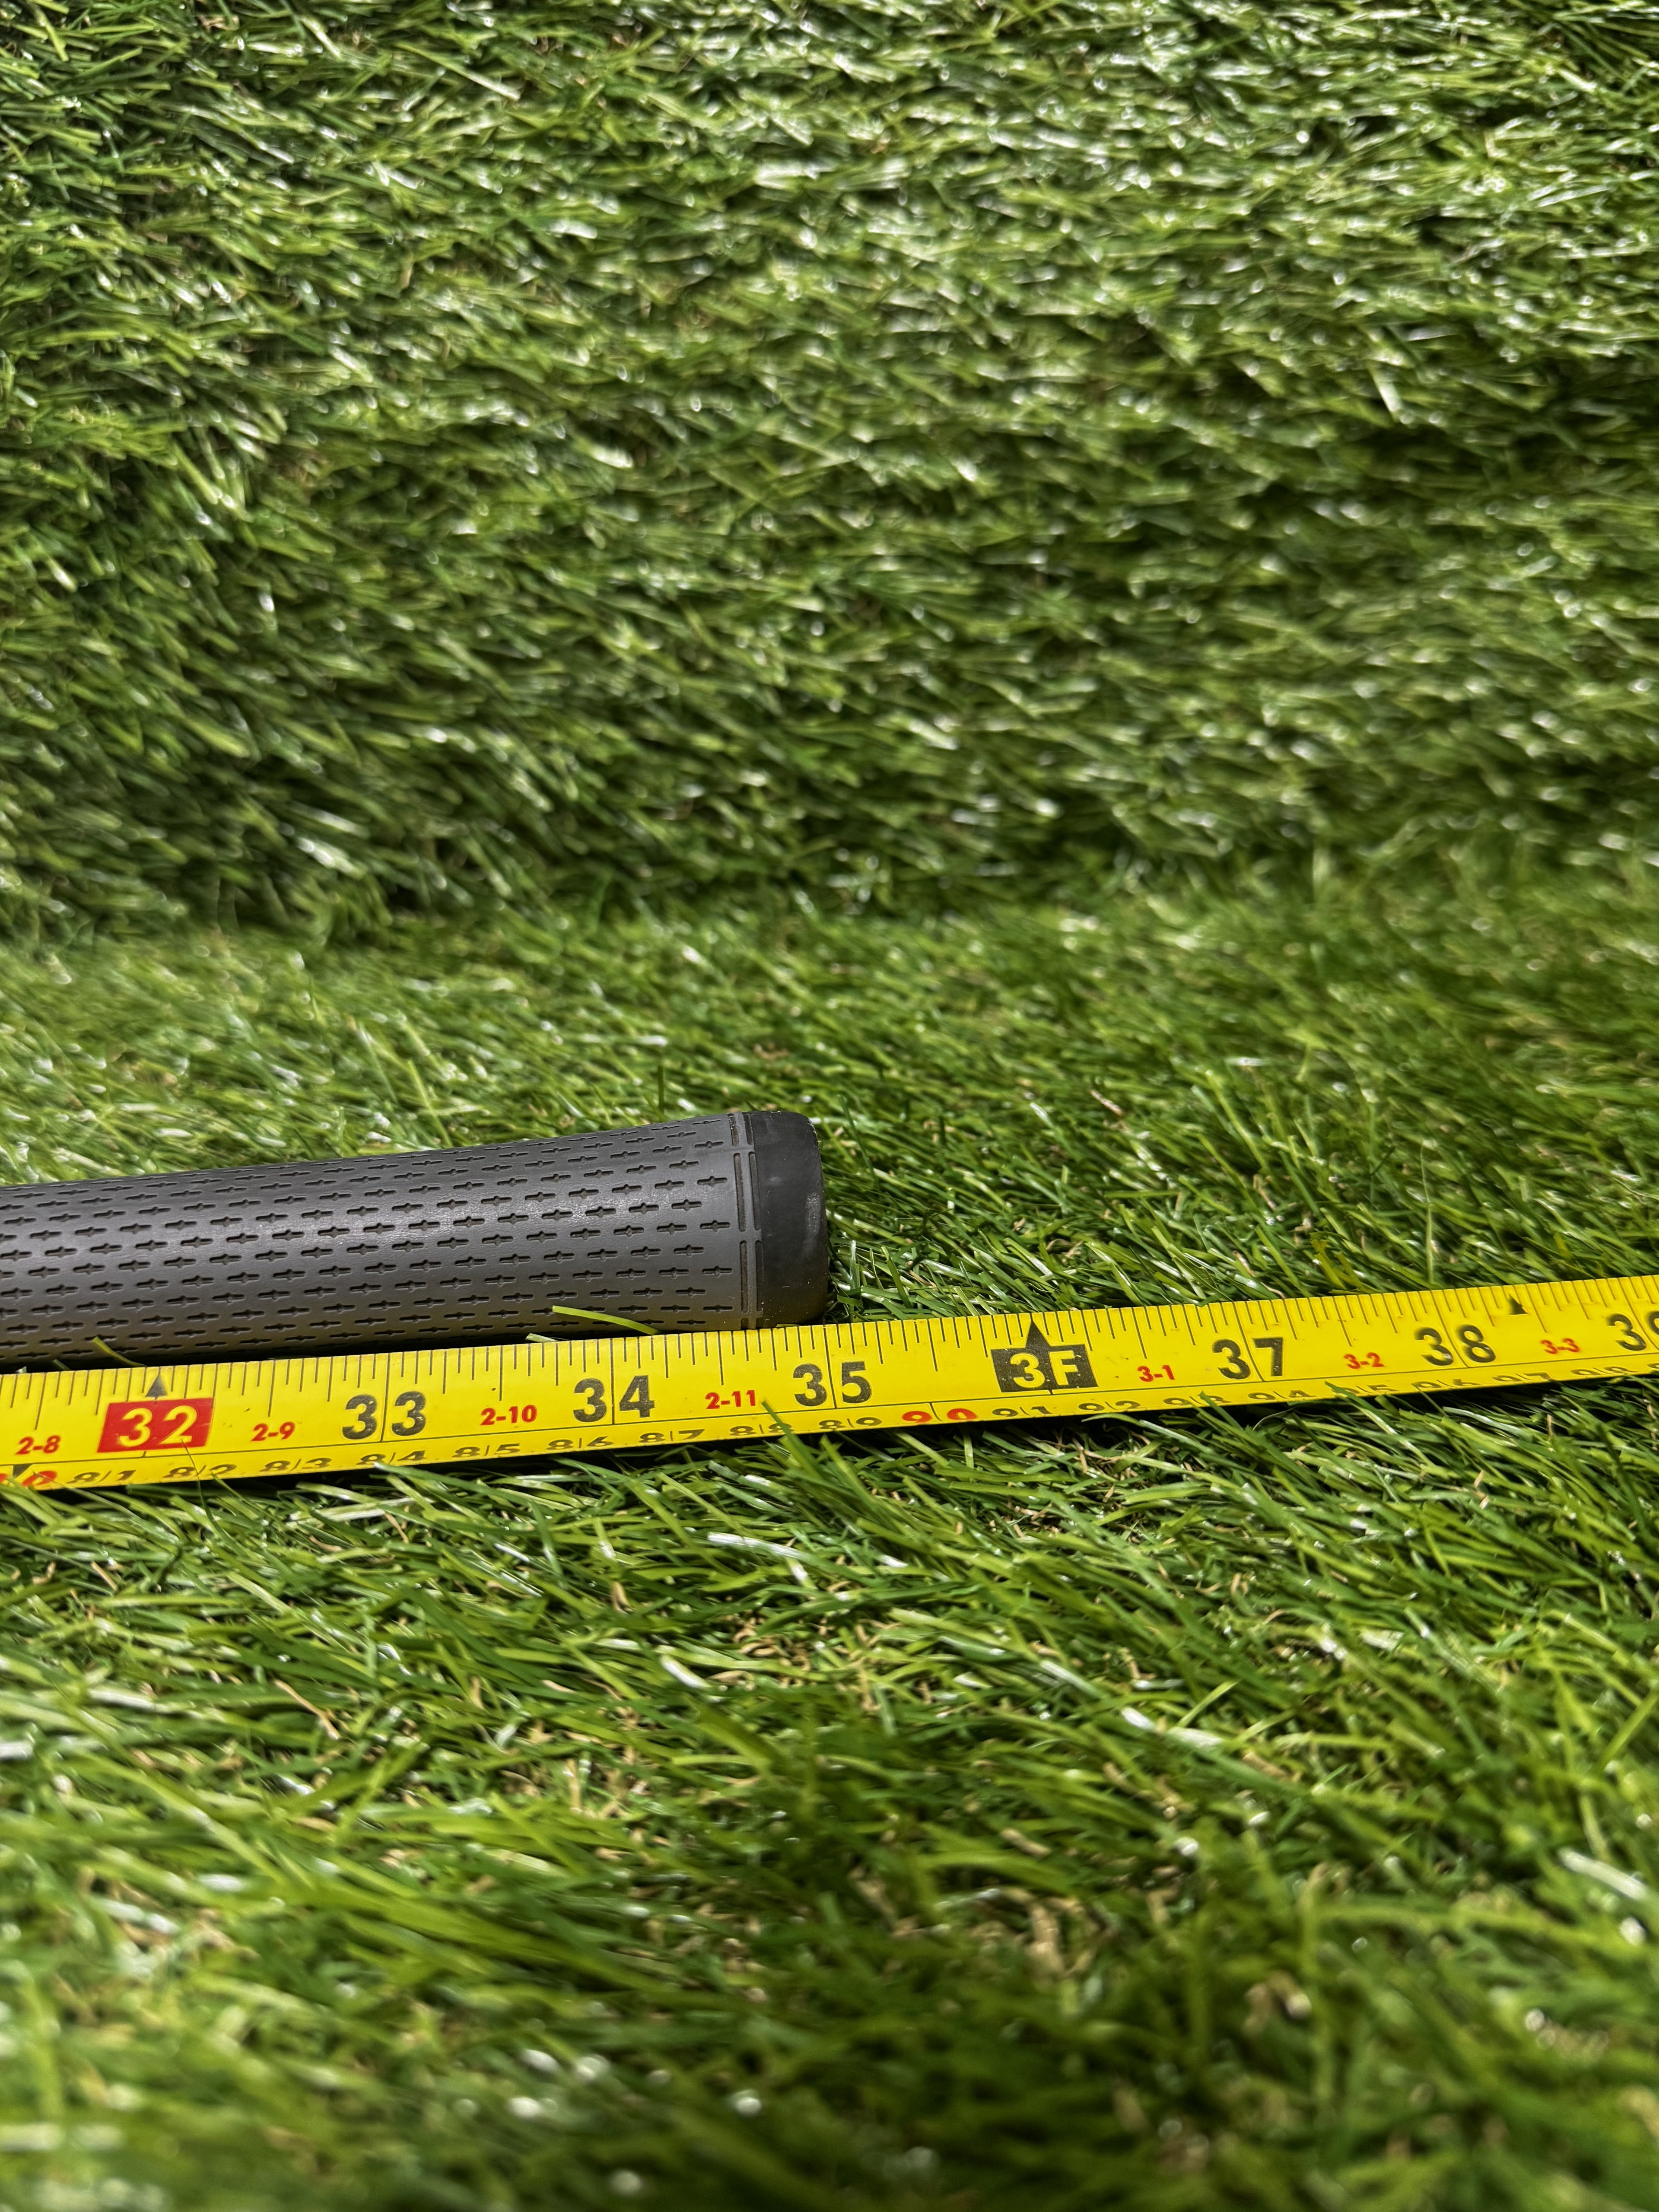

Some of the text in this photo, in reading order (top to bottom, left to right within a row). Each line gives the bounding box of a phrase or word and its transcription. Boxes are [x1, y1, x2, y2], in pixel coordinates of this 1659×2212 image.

[16, 1435, 60, 1455] 2-8
[118, 1405, 197, 1448] 32
[251, 1421, 296, 1442] 2-9
[342, 1391, 426, 1440] 33
[480, 1405, 537, 1426] 2-10
[573, 1375, 655, 1423] 34
[705, 1390, 756, 1410] 2-11
[793, 1361, 872, 1407] 35
[1010, 1350, 1078, 1388] 3F
[1137, 1365, 1175, 1382] 3-1
[1211, 1336, 1284, 1380] 37
[1344, 1352, 1385, 1369] 3-2
[1414, 1324, 1497, 1367] 38
[1540, 1338, 1580, 1354] 3-3
